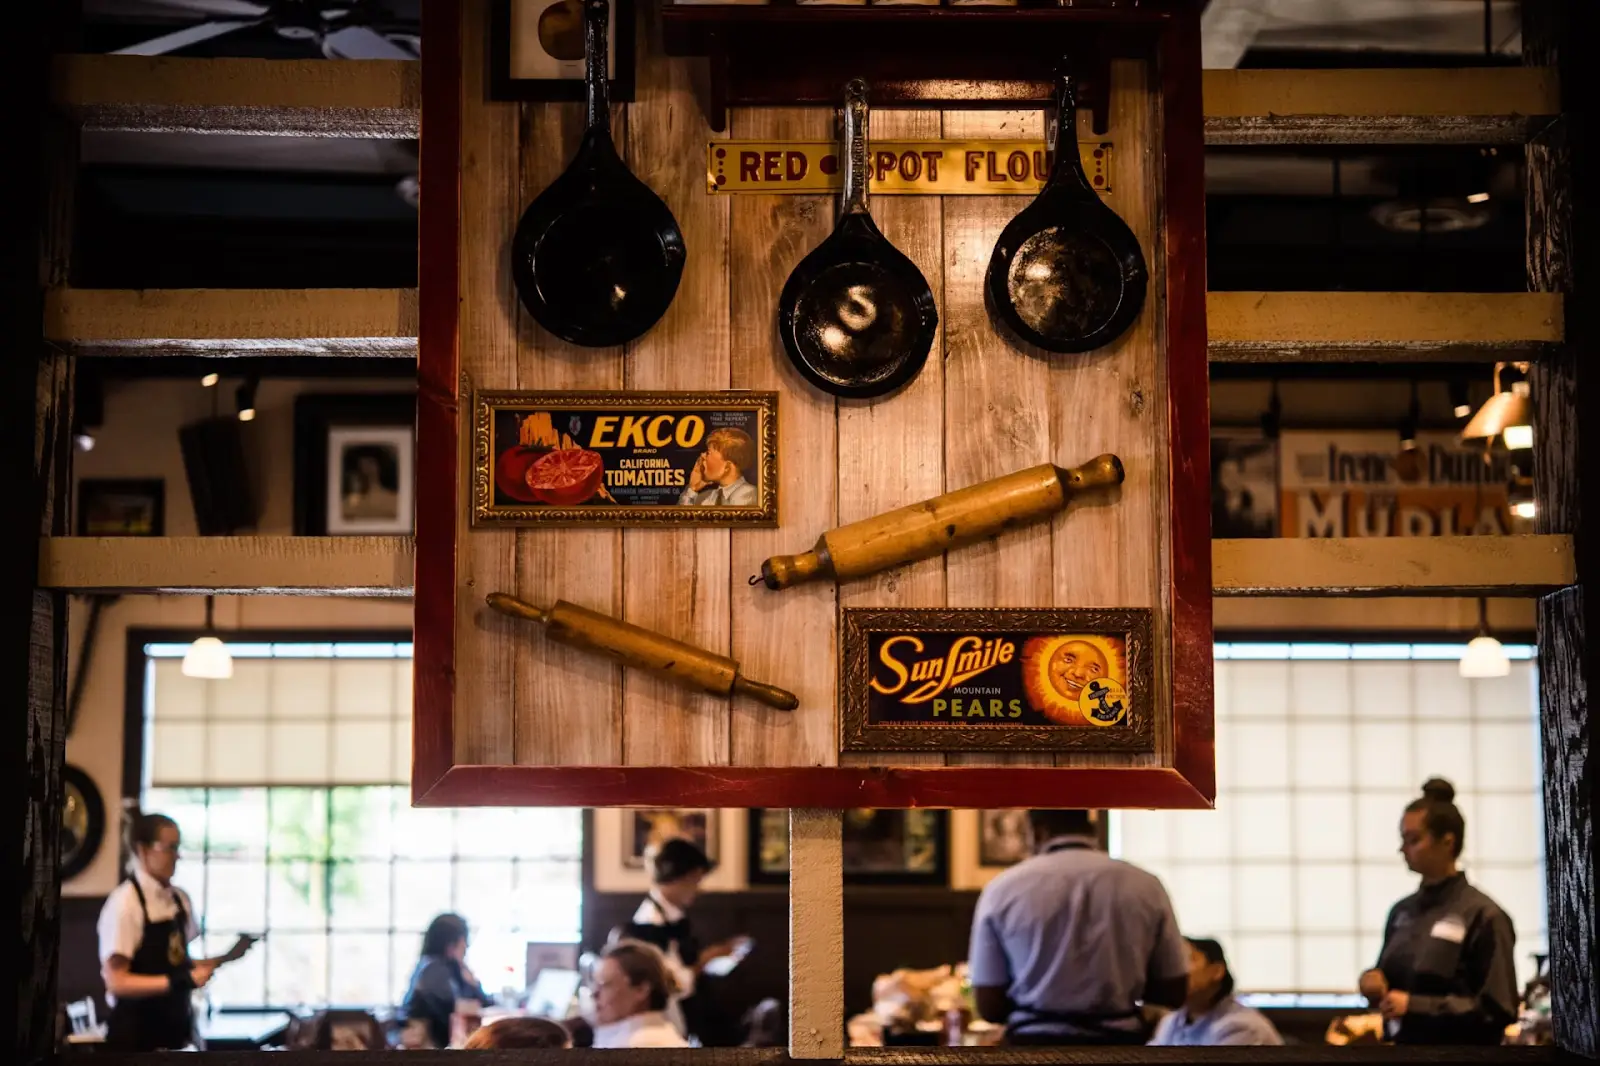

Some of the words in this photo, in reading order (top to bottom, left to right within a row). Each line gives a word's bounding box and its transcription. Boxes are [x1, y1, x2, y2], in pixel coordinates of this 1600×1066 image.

[740, 151, 809, 181] RED
[965, 151, 1050, 181] FLOU
[589, 415, 705, 448] EKCO
[620, 459, 670, 468] CALIFORNIA
[605, 469, 685, 486] TOMATOES
[953, 687, 1000, 695] MOUNTAIN
[933, 698, 1022, 717] PEARS
